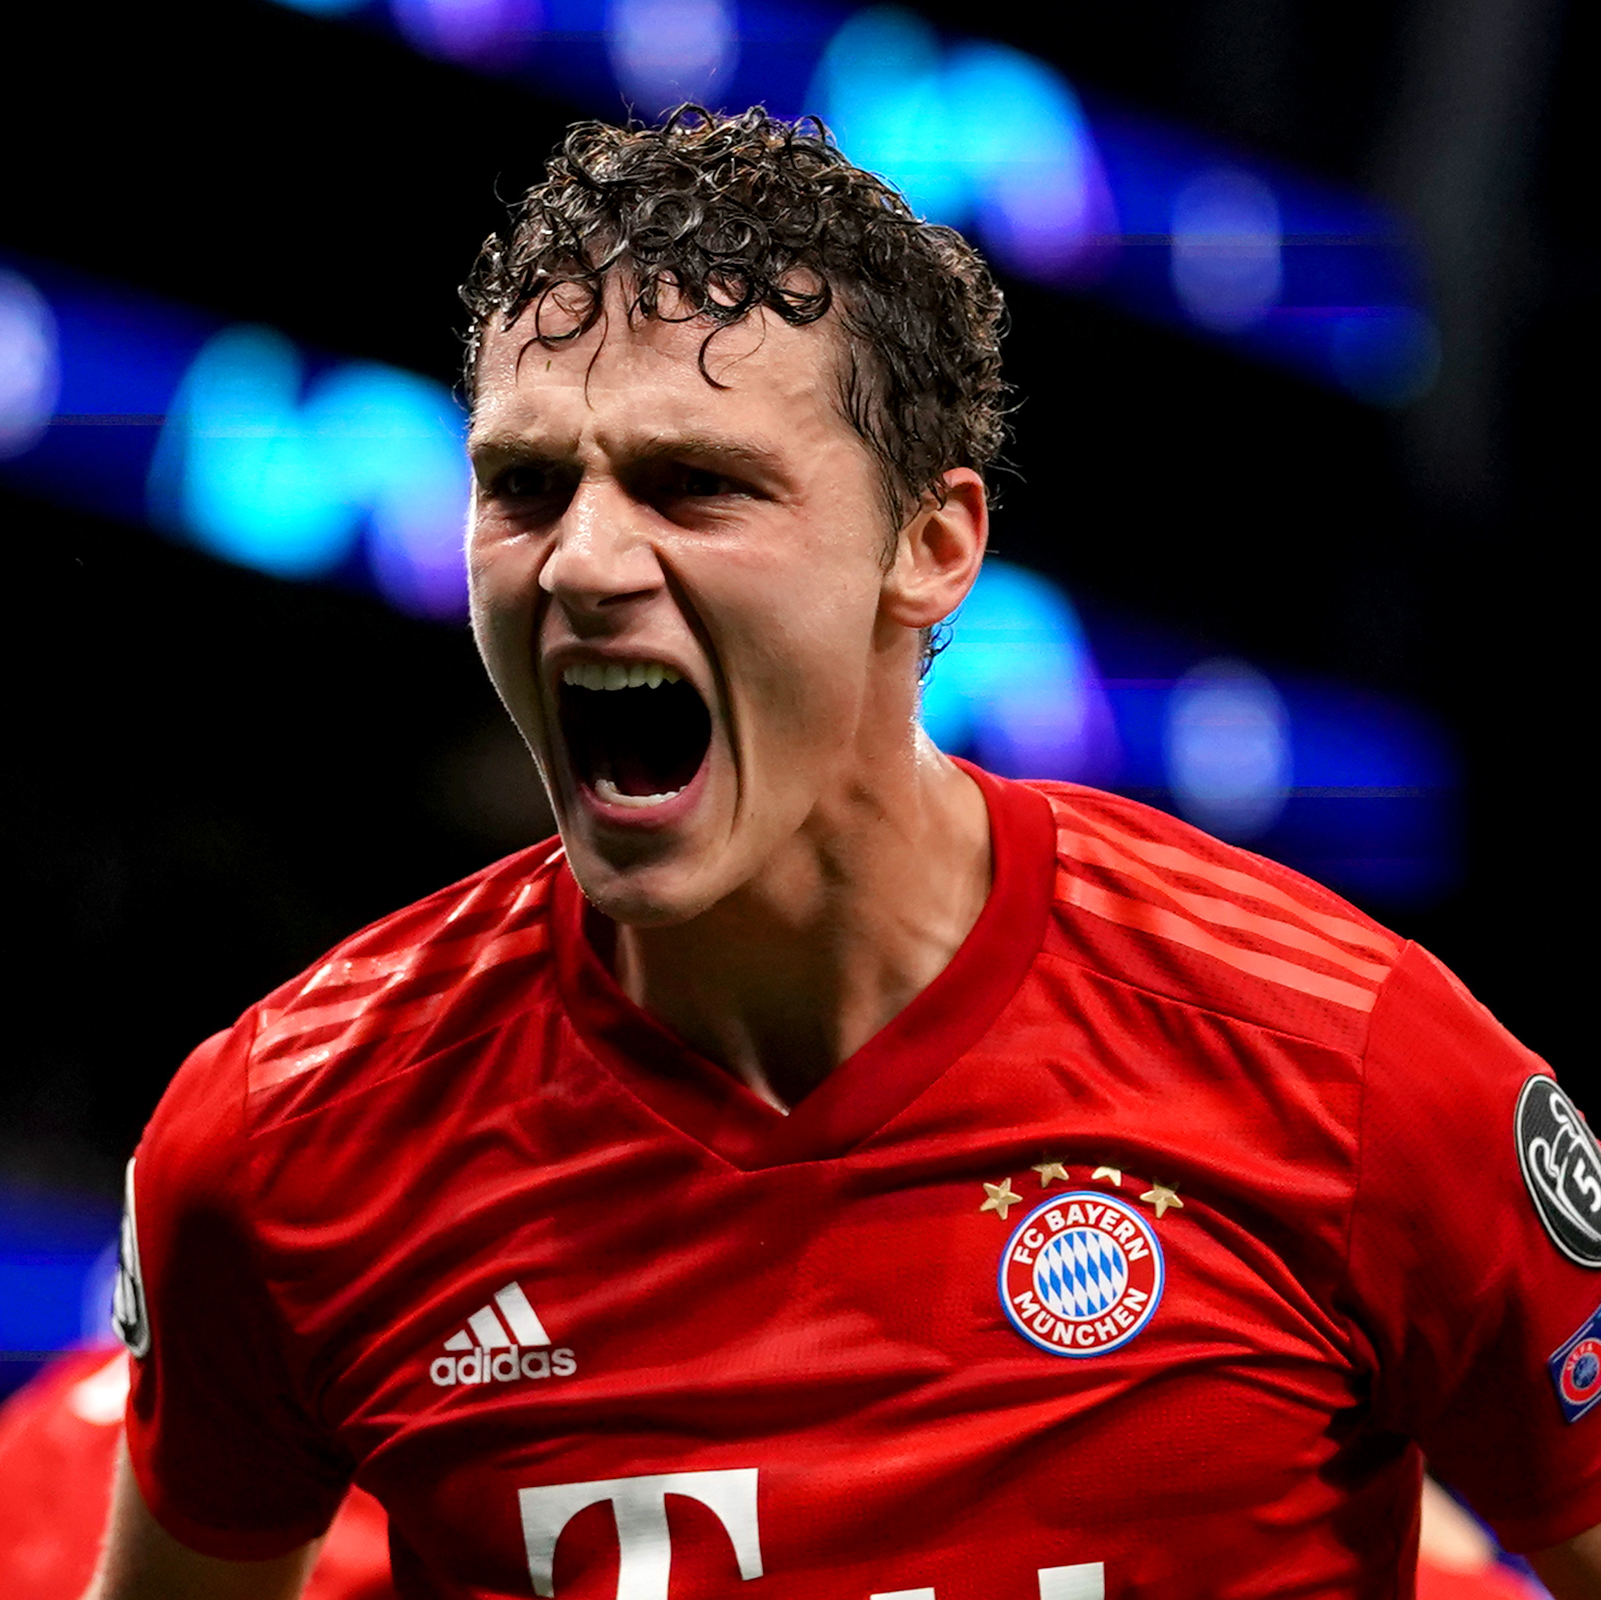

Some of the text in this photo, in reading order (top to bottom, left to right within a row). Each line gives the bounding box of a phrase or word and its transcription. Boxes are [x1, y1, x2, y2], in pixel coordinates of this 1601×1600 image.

[1012, 1203, 1149, 1265] FC BAYERN
[1013, 1287, 1149, 1347] MÜNCHEN
[429, 1343, 578, 1387] adidas
